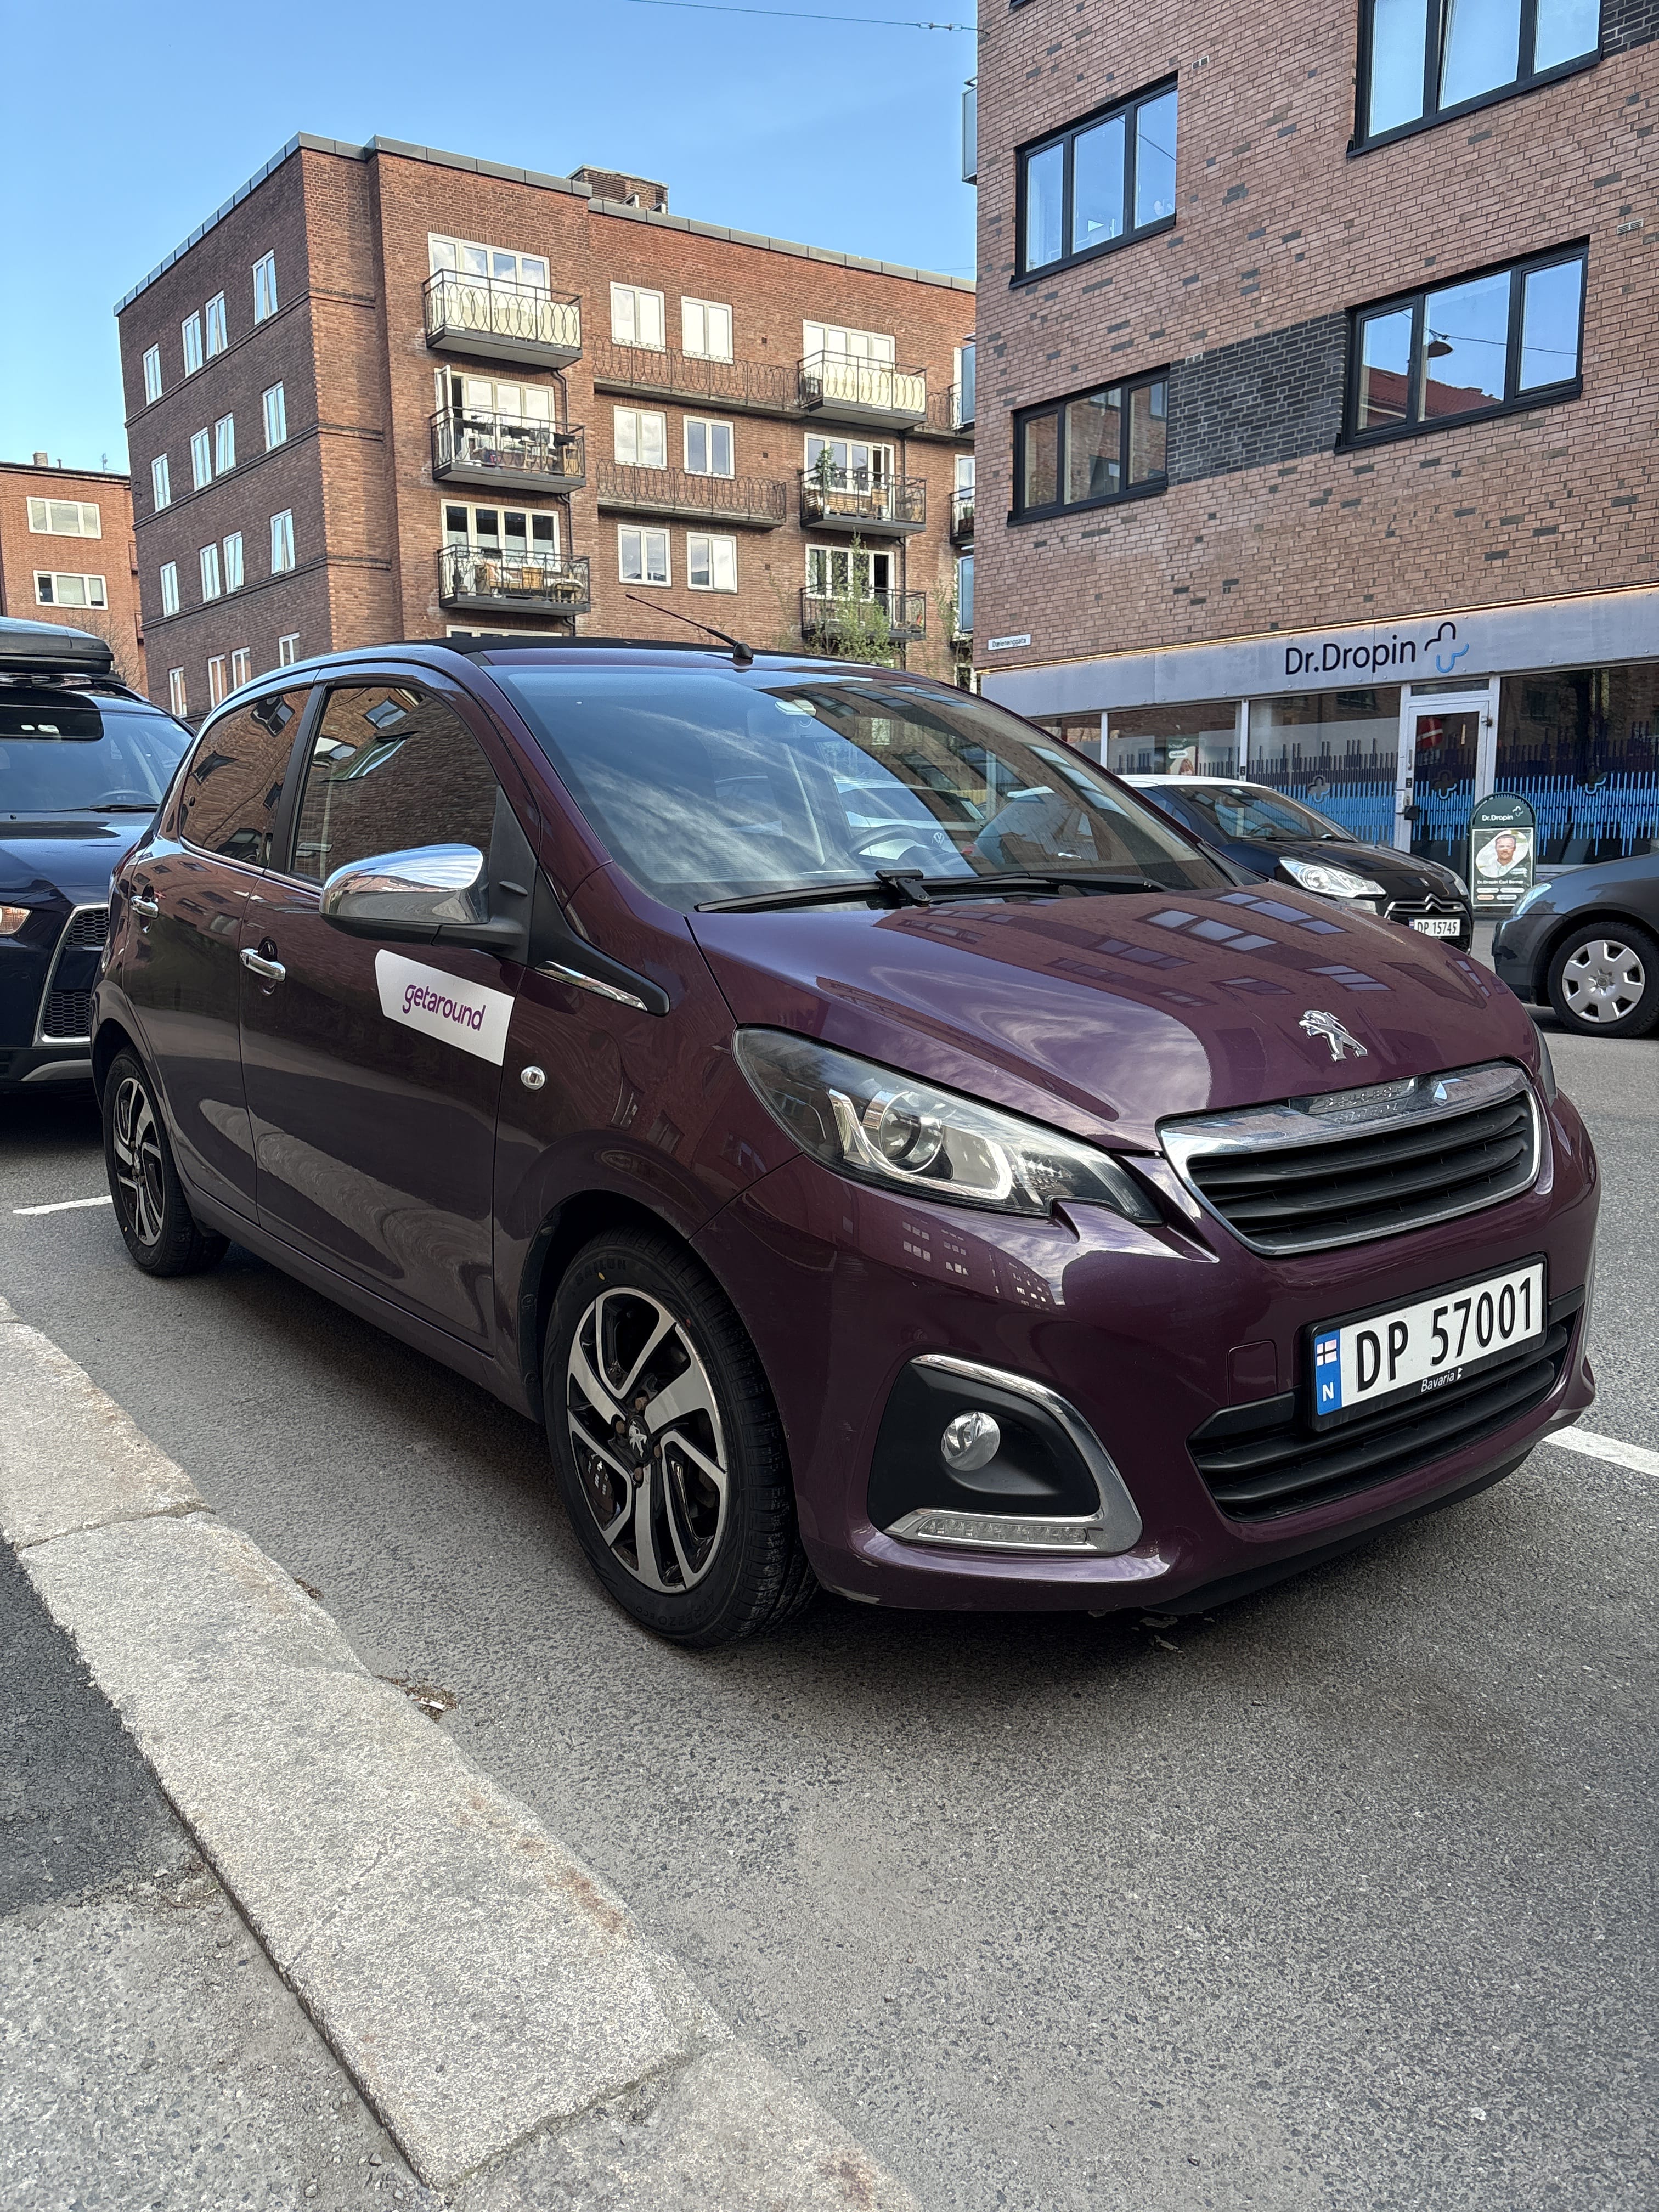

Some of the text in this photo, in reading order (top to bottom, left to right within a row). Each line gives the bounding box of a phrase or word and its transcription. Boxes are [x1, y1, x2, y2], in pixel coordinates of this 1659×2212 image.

[1285, 634, 1415, 675] Dr.Dropin
[1481, 814, 1514, 822] Dr.Dropin
[1417, 921, 1457, 934] DP 15745
[402, 984, 486, 1031] getaround
[1357, 1277, 1531, 1392] DP 57001
[1323, 1383, 1334, 1402] N
[1420, 1370, 1455, 1393] Bavaria
